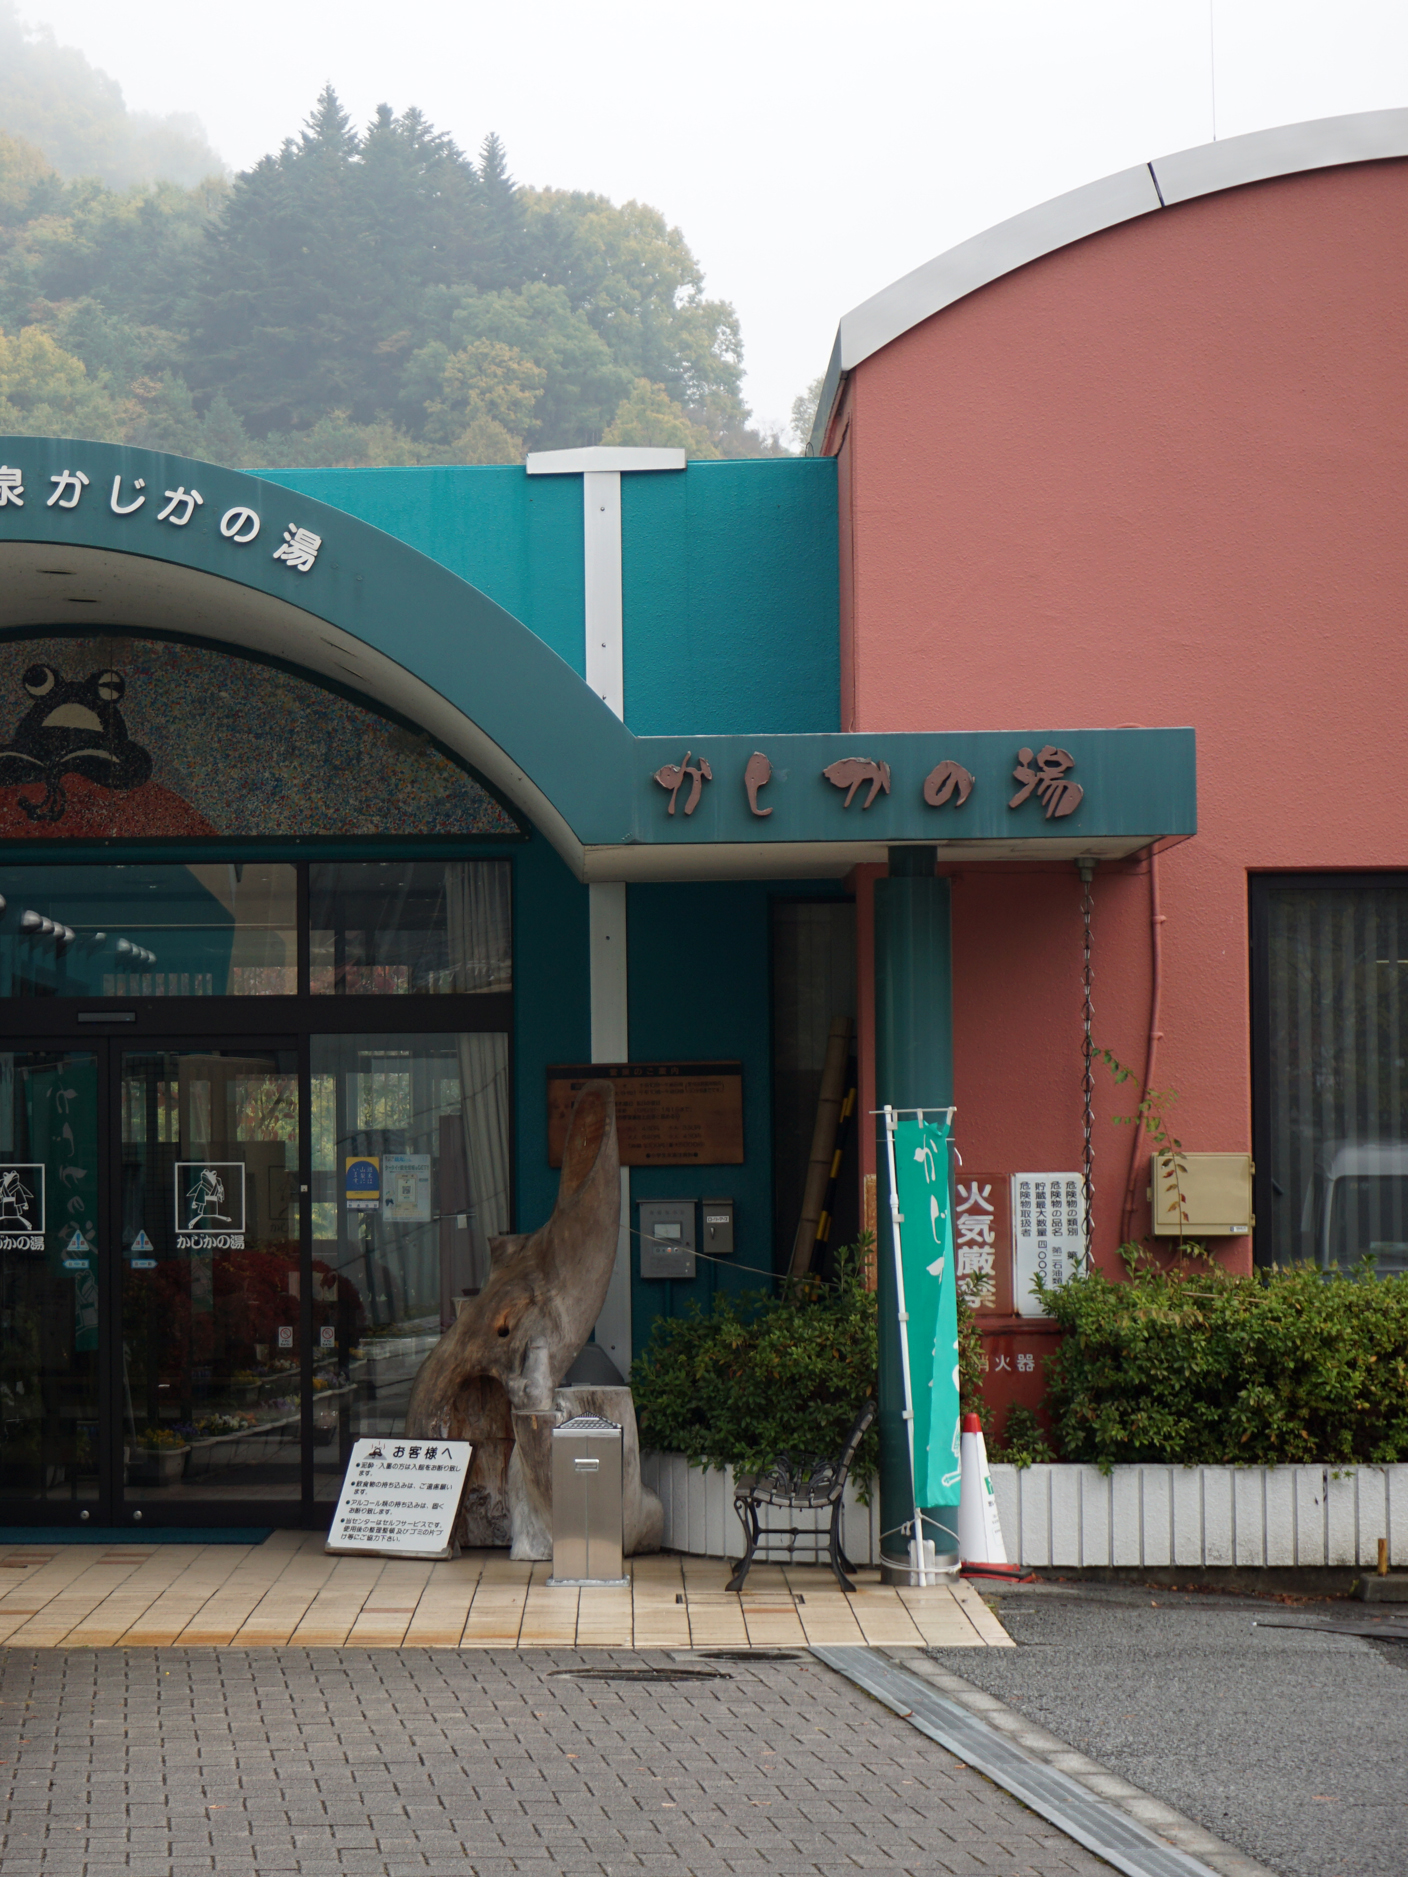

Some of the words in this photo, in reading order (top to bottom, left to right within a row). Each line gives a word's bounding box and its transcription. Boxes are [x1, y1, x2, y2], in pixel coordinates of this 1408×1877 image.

[1019, 1180, 1032, 1237] 危険物取扱者
[1035, 1181, 1048, 1237] 貯蔵最大数量
[1050, 1180, 1063, 1237] 危険物の品名
[1065, 1180, 1079, 1237] 危険物の類別
[176, 1234, 245, 1250] かじかの湯
[956, 1181, 996, 1308] 火気厳禁
[393, 1445, 453, 1460] お客様へ
